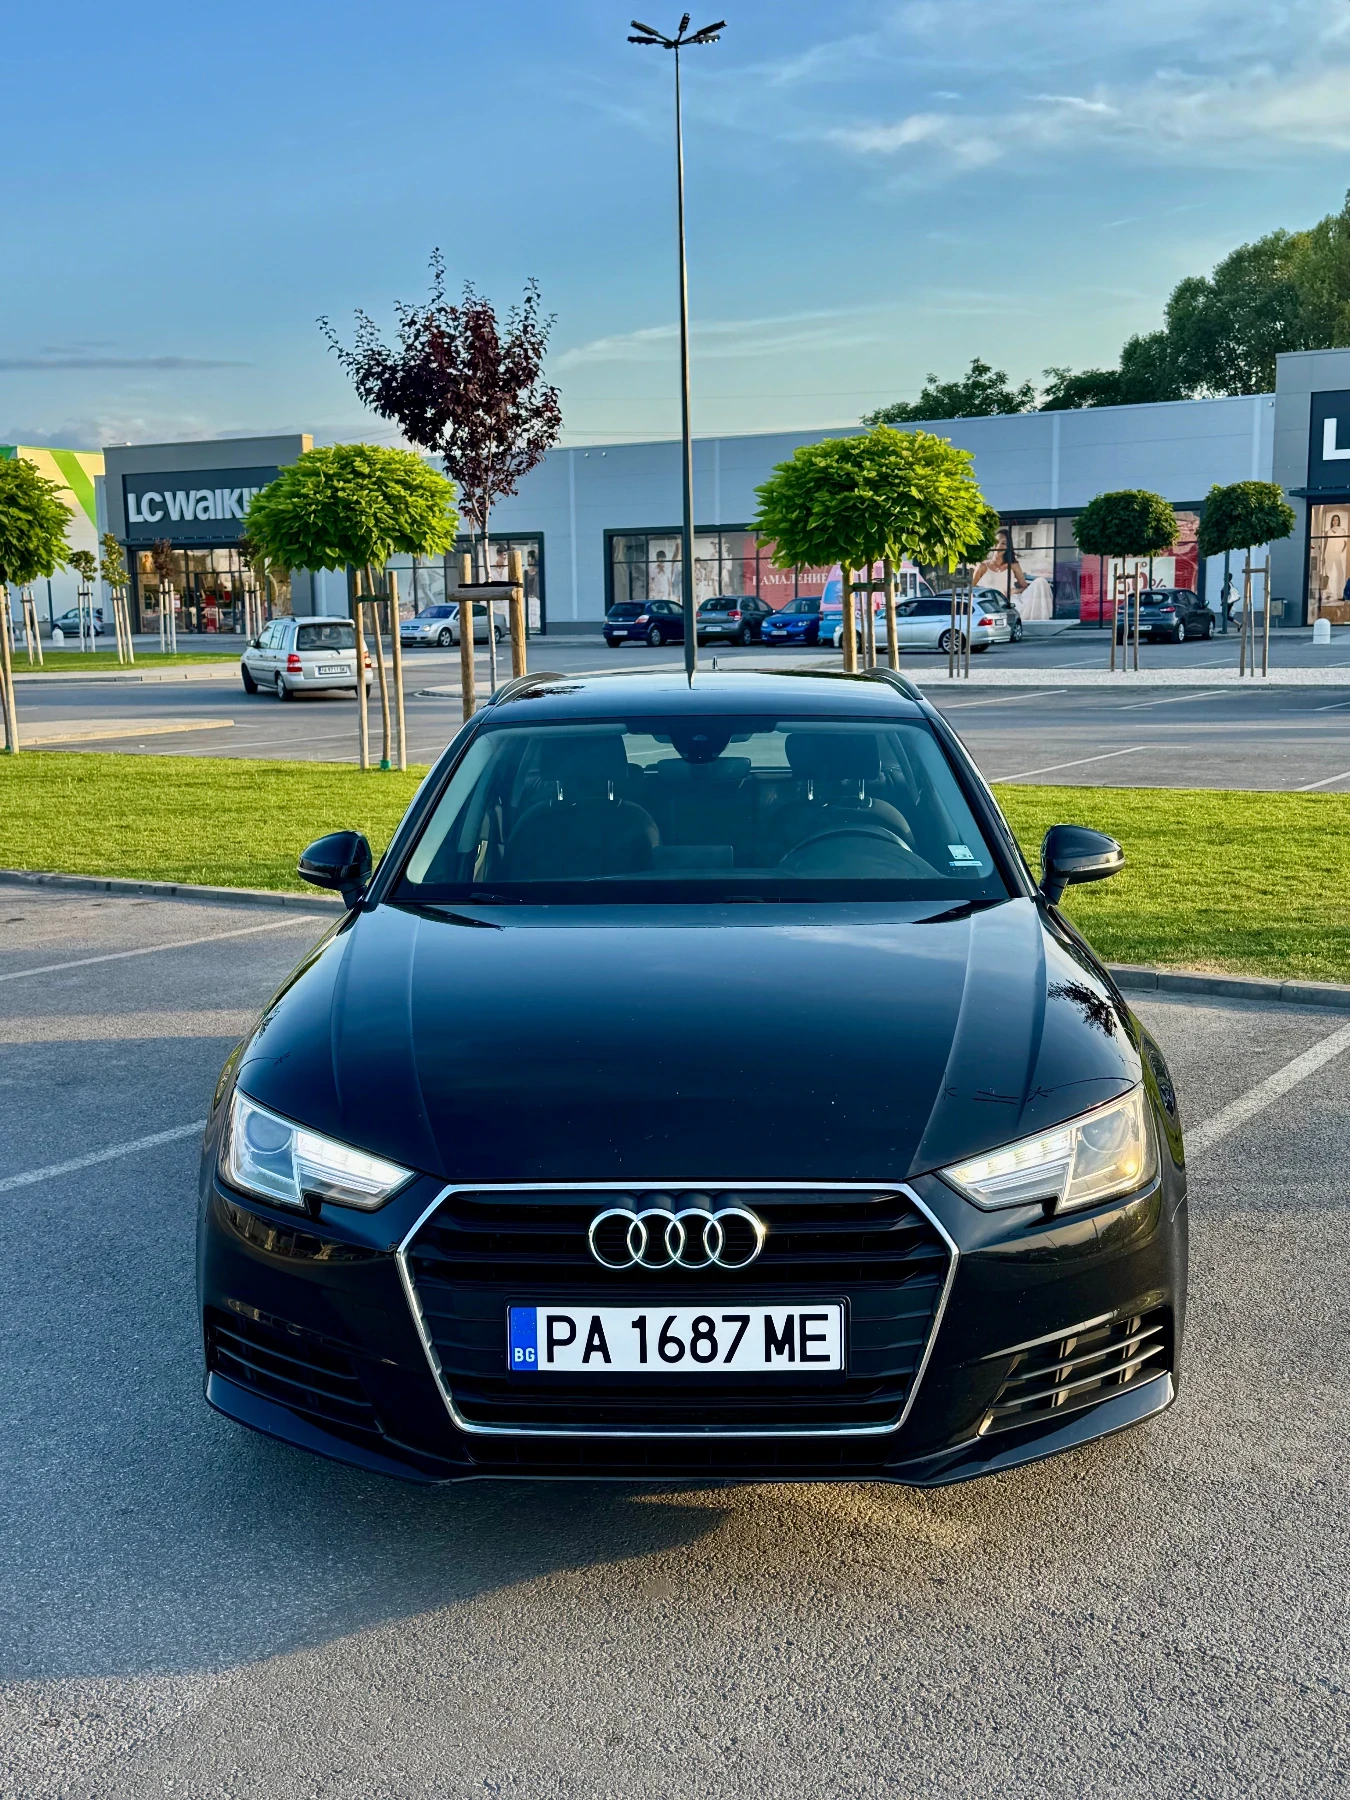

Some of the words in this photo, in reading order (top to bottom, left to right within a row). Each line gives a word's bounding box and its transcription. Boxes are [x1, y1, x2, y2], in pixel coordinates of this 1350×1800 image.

[127, 491, 164, 523] LC
[546, 1314, 612, 1363] PA
[631, 1315, 750, 1363] 1687
[764, 1313, 831, 1363] ME
[514, 1347, 535, 1362] BG
